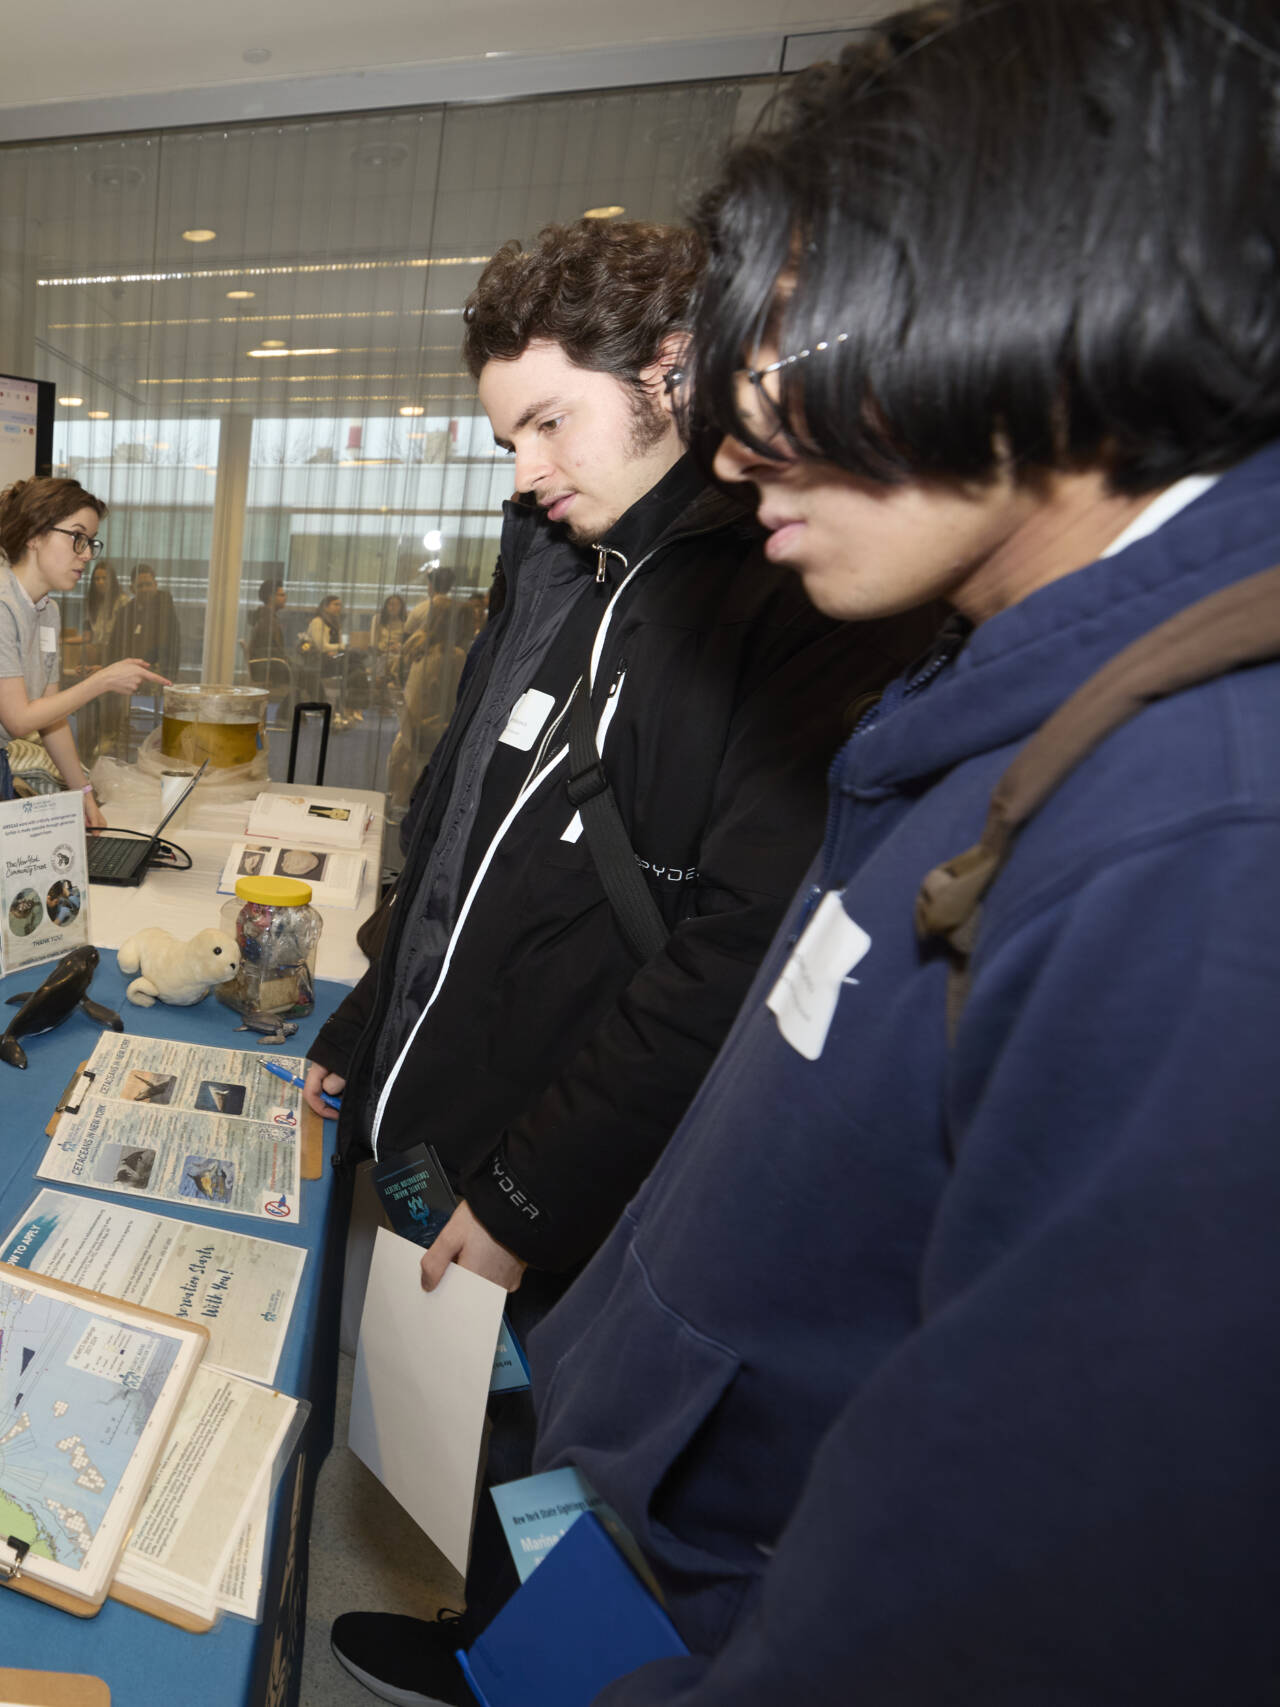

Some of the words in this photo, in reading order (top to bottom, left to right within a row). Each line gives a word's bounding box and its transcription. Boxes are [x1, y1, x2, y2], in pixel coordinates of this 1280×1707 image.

[633, 854, 699, 881] SPYDE
[90, 1104, 109, 1119] YORK
[86, 1118, 103, 1133] NEW
[64, 1137, 98, 1175] CETACEANS
[400, 1170, 430, 1187] CONSERVATION
[384, 1182, 401, 1196] SOCIETY
[392, 1189, 409, 1200] MARINE
[410, 1182, 427, 1195] ATLANTIC
[492, 1160, 539, 1220] YDER
[19, 1223, 42, 1245] APPLY
[10, 1244, 29, 1257] TO
[3, 1256, 20, 1267] OW
[176, 1273, 202, 1318] servation
[192, 1245, 215, 1275] Starts
[513, 1516, 525, 1525] New
[525, 1512, 539, 1521] York
[540, 1507, 556, 1519] State
[557, 1502, 586, 1515] Sightings
[520, 1534, 559, 1552] Marine
